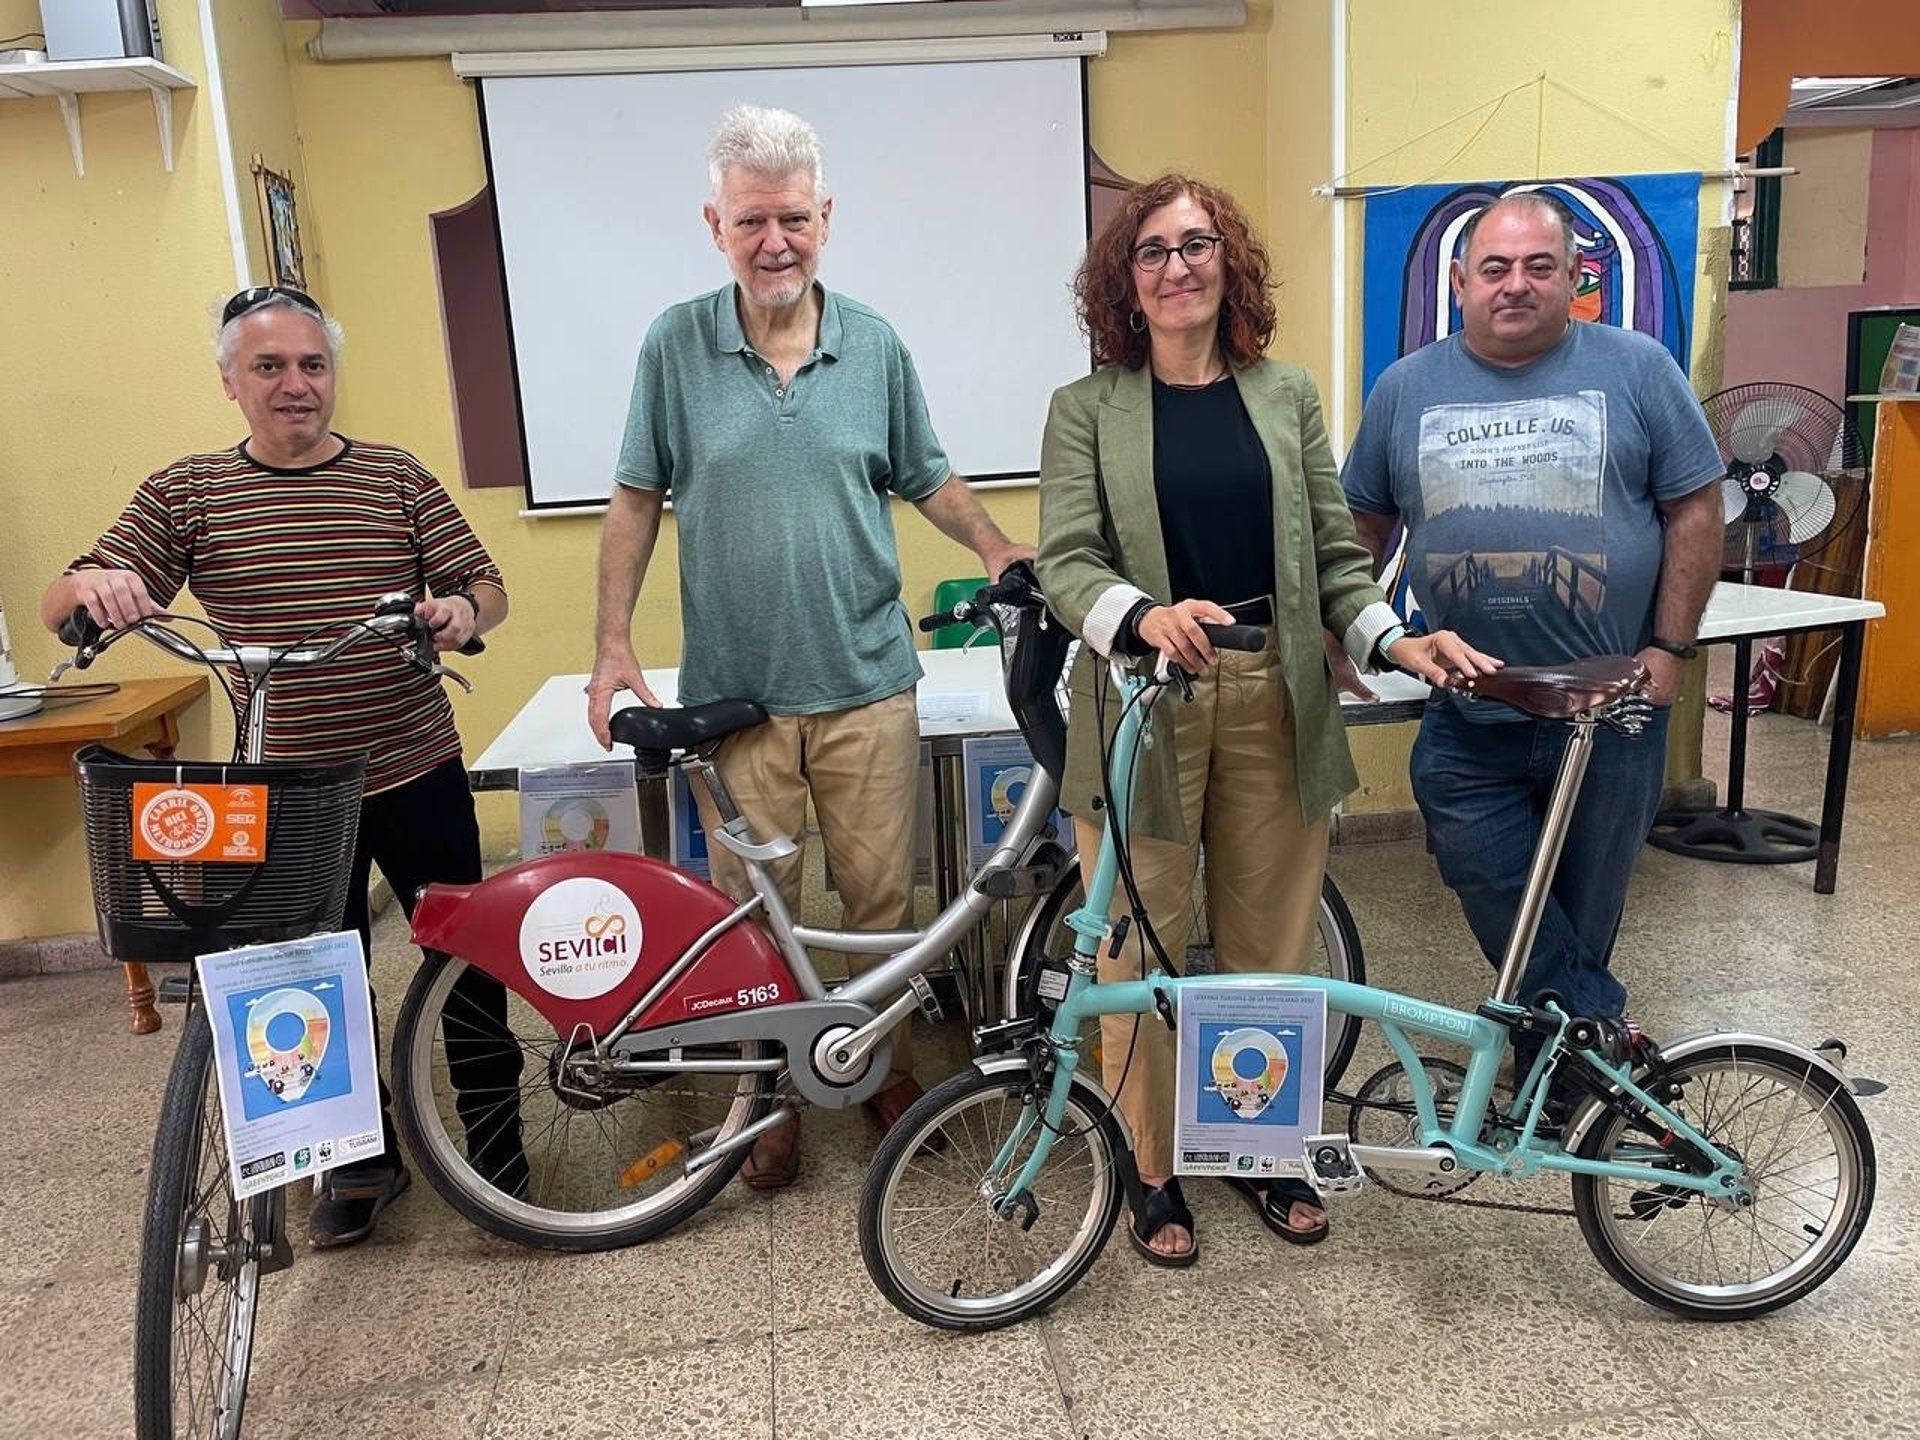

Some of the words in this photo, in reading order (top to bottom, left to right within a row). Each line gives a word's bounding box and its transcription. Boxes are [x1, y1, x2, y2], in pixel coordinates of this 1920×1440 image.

[1461, 459, 1487, 469] INTO
[1494, 457, 1515, 468] THE
[1522, 452, 1558, 465] WOODS
[149, 798, 188, 821] CARRIL
[164, 810, 188, 827] BICI
[539, 934, 627, 963] SEVICI
[539, 964, 573, 977] Sevilla
[575, 964, 583, 973] a
[584, 962, 597, 972] tu
[691, 996, 733, 1011] JCDecaux
[737, 983, 780, 1007] 5163
[1391, 1001, 1468, 1031] BROMPTON
